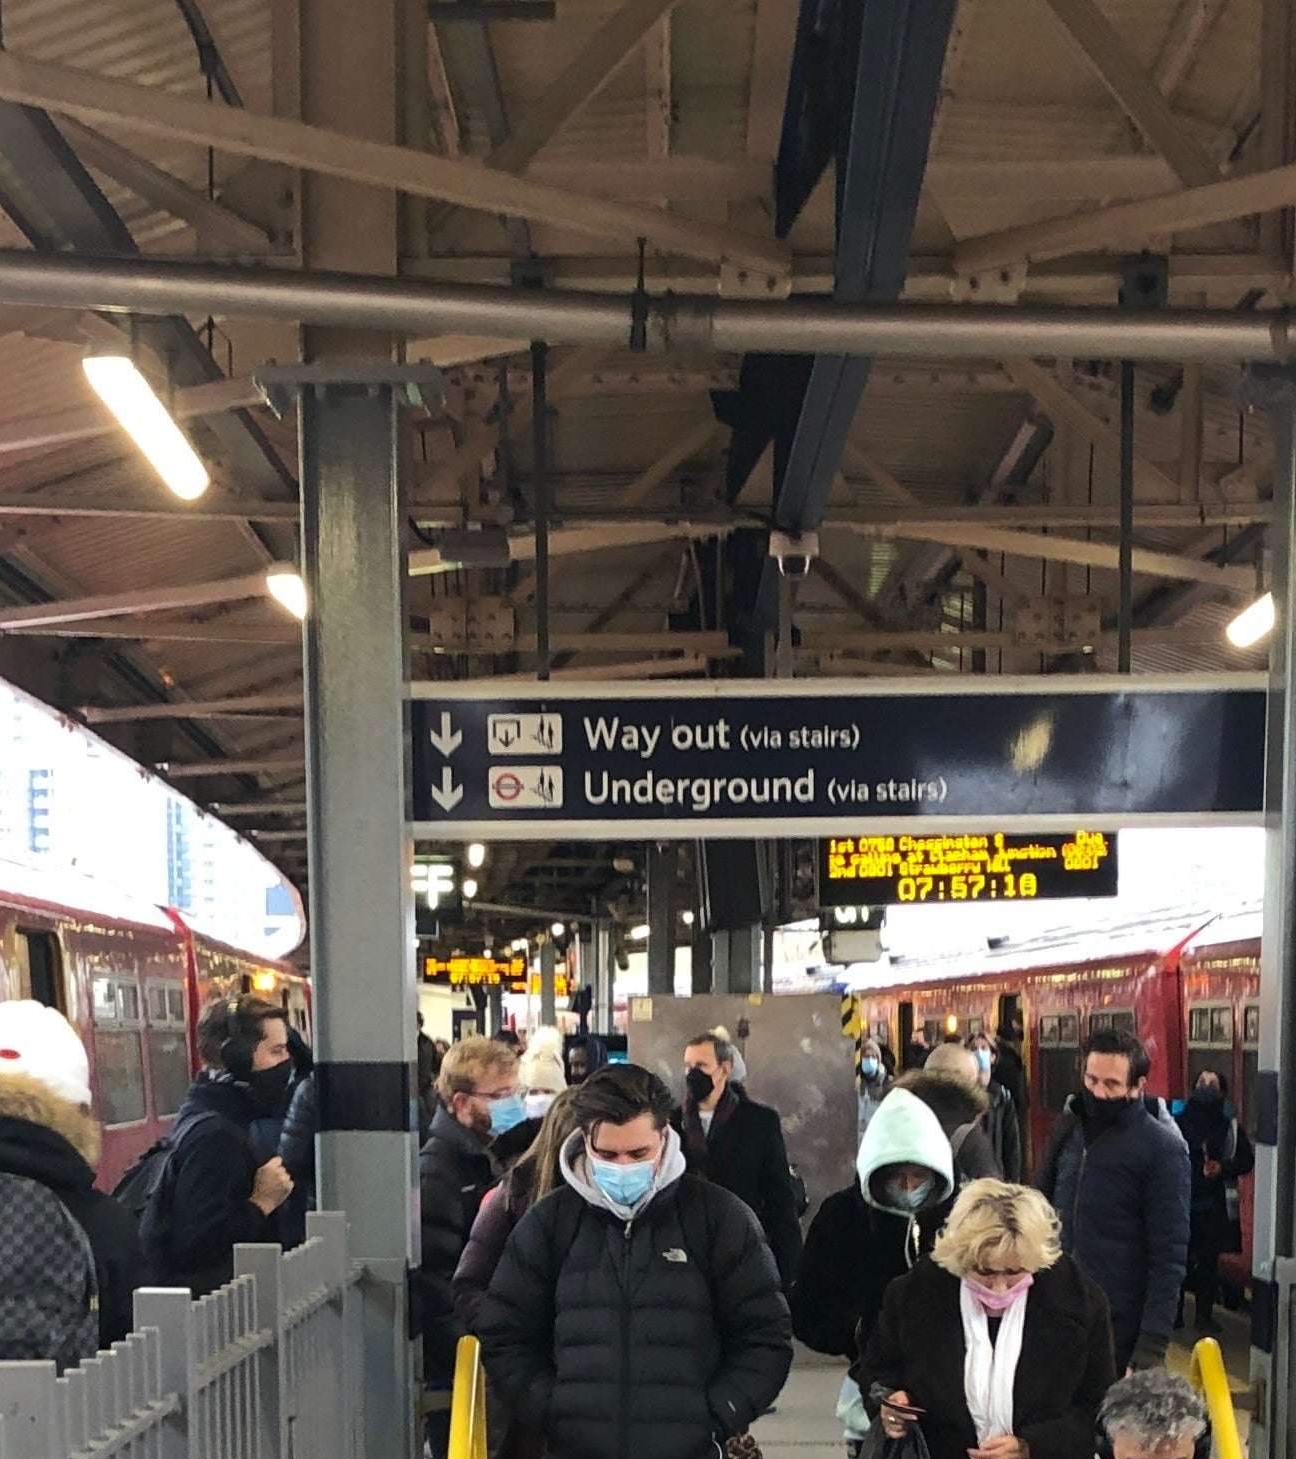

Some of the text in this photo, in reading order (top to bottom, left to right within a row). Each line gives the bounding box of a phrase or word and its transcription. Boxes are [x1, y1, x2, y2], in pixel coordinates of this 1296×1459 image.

[583, 716, 860, 758] Way out (via stairs)
[583, 768, 948, 811] Underground (via stairs)
